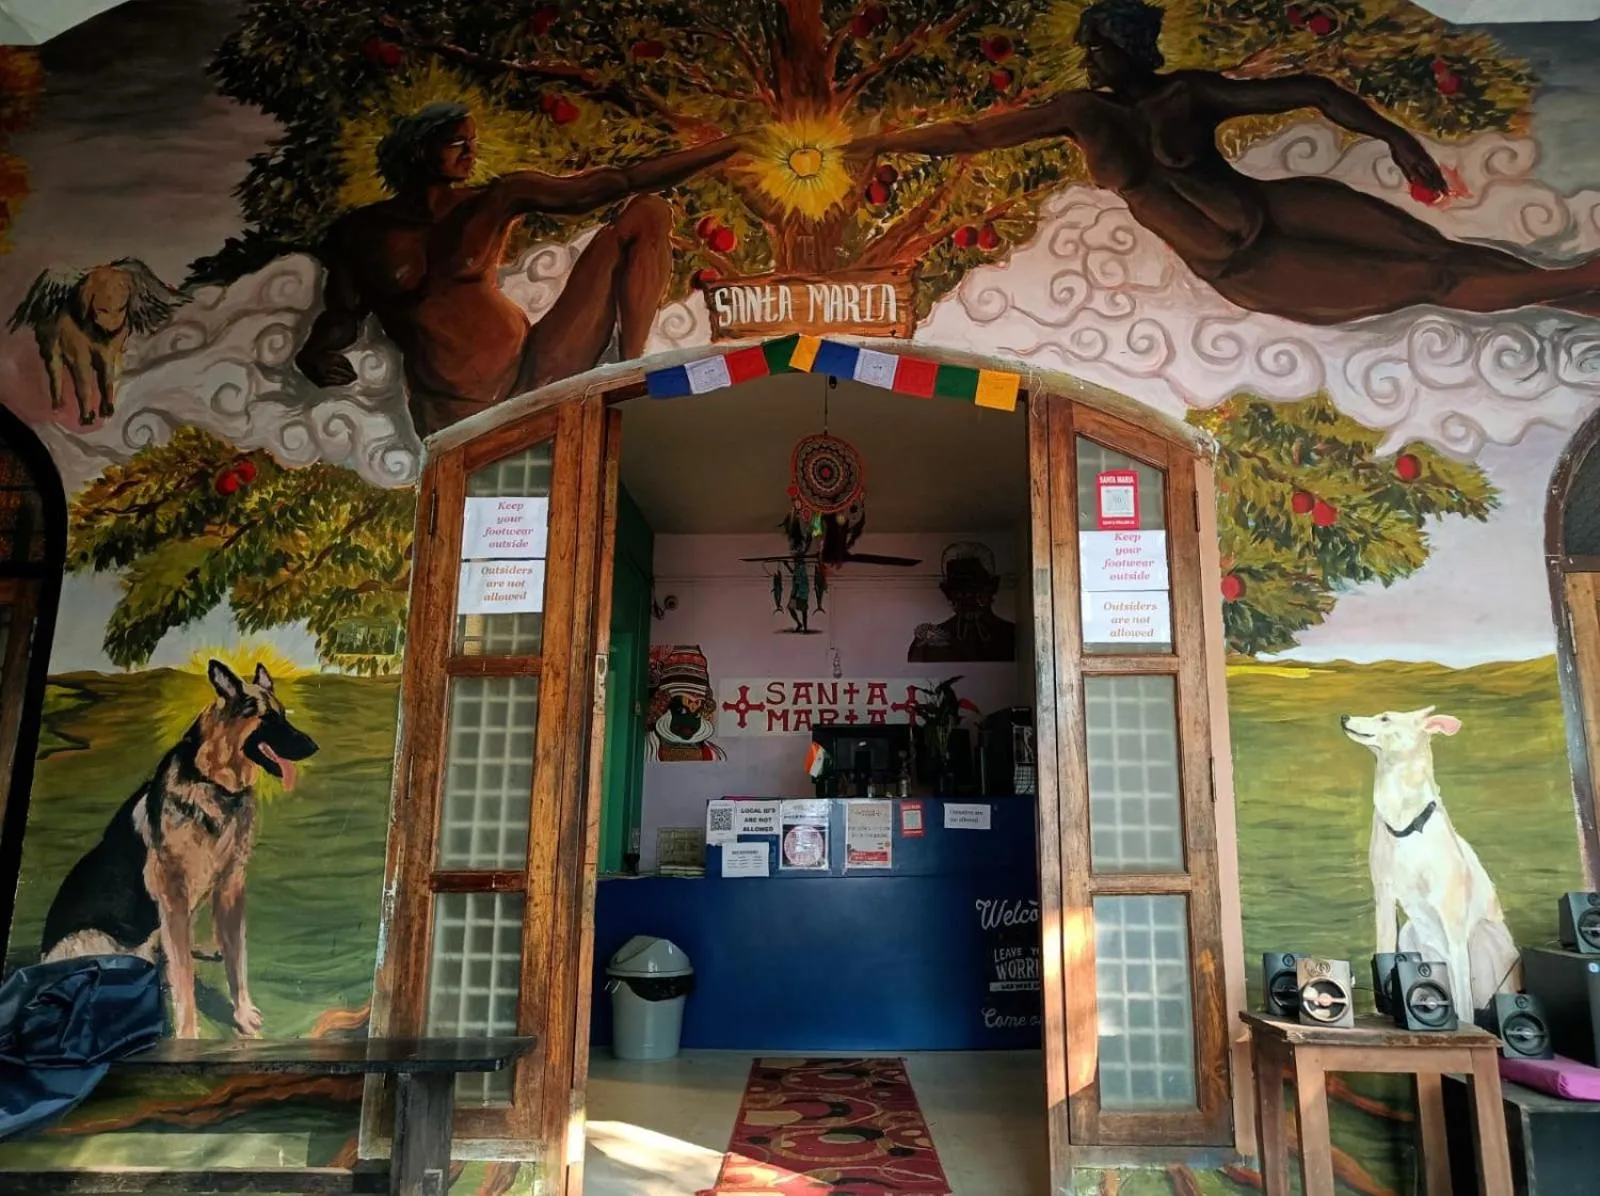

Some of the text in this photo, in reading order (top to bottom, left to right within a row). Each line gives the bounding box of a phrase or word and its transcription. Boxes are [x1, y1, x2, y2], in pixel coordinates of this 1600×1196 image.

[806, 283, 897, 323] MARIA
[498, 502, 523, 512] Keep
[497, 516, 523, 524] your
[483, 527, 533, 537] footwear
[1114, 533, 1141, 543] Keep
[489, 540, 528, 548] outside
[1115, 547, 1142, 556] your
[1102, 559, 1154, 569] footwear
[480, 566, 533, 576] Outsiders
[1109, 570, 1151, 581] outside
[486, 579, 525, 588] are not
[484, 592, 526, 601] allowed
[1103, 600, 1158, 611] Outsiders
[1110, 614, 1151, 624] are not
[1109, 626, 1154, 638] allowed
[994, 947, 1023, 962] LEAVE
[981, 1007, 1027, 1028] Come
